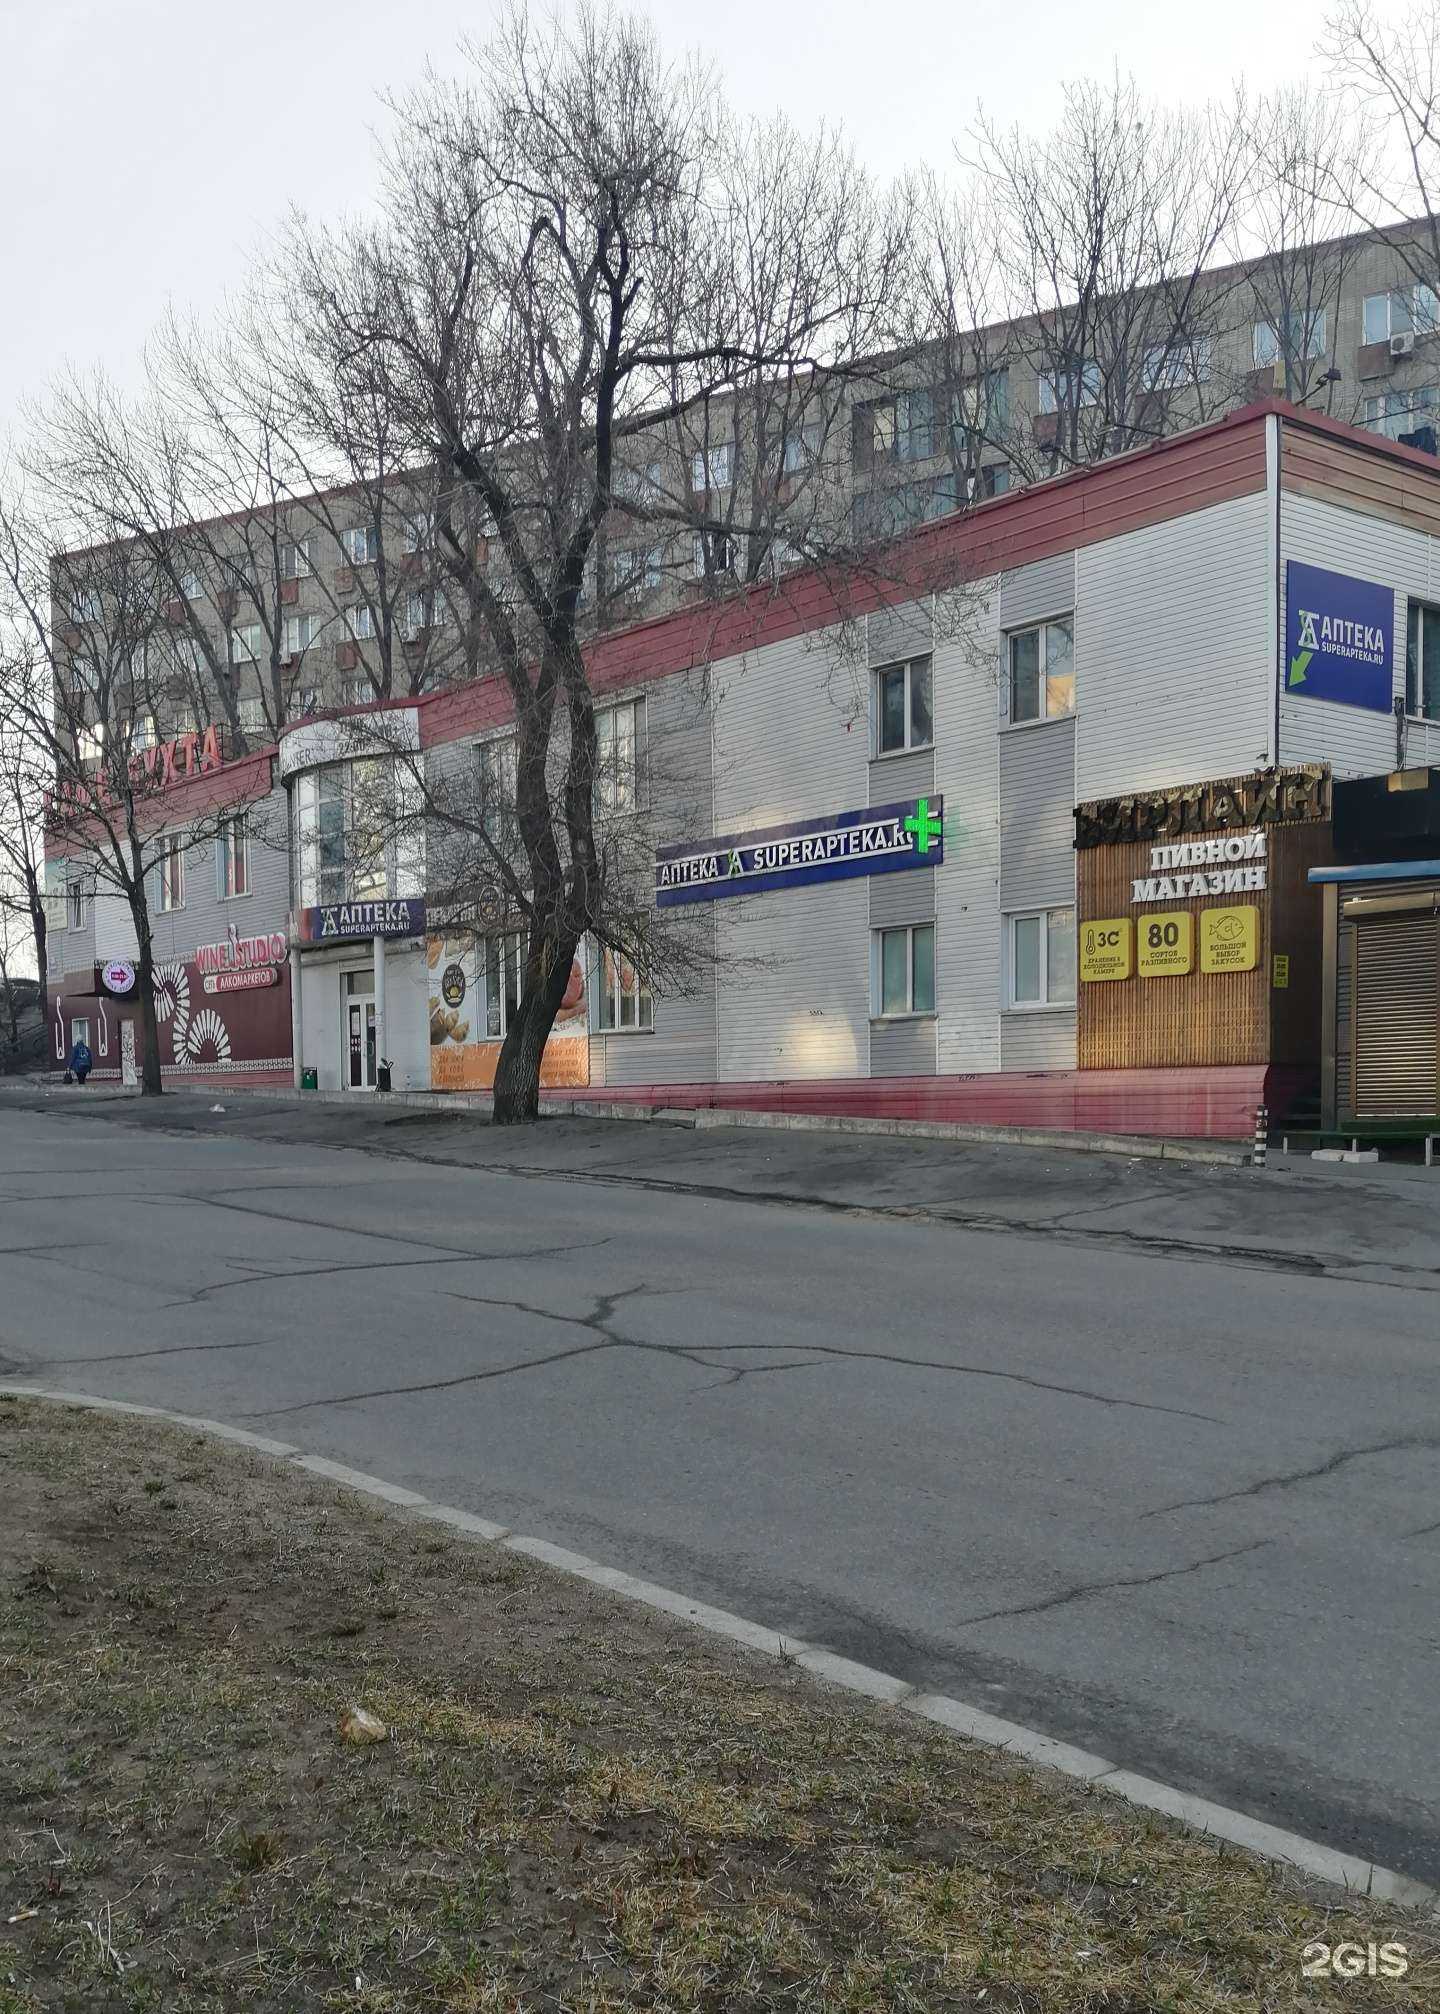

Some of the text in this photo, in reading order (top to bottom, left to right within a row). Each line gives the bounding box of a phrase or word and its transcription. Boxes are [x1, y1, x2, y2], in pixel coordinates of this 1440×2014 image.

[1321, 616, 1384, 652] АПТЕКА
[1322, 641, 1384, 665] SUPERAPTEKA.RU
[1150, 825, 1267, 870] ПИВНОЙ
[661, 856, 719, 885] АПТЕКА
[1130, 865, 1267, 903] МАГАЗИН
[340, 901, 411, 924] АПТЕКА
[340, 921, 410, 935] SUPERAPTEKA.RU
[1148, 922, 1179, 948] 80
[234, 932, 287, 971] STUDIO
[1141, 956, 1187, 966] РАЗЛИВНОГО
